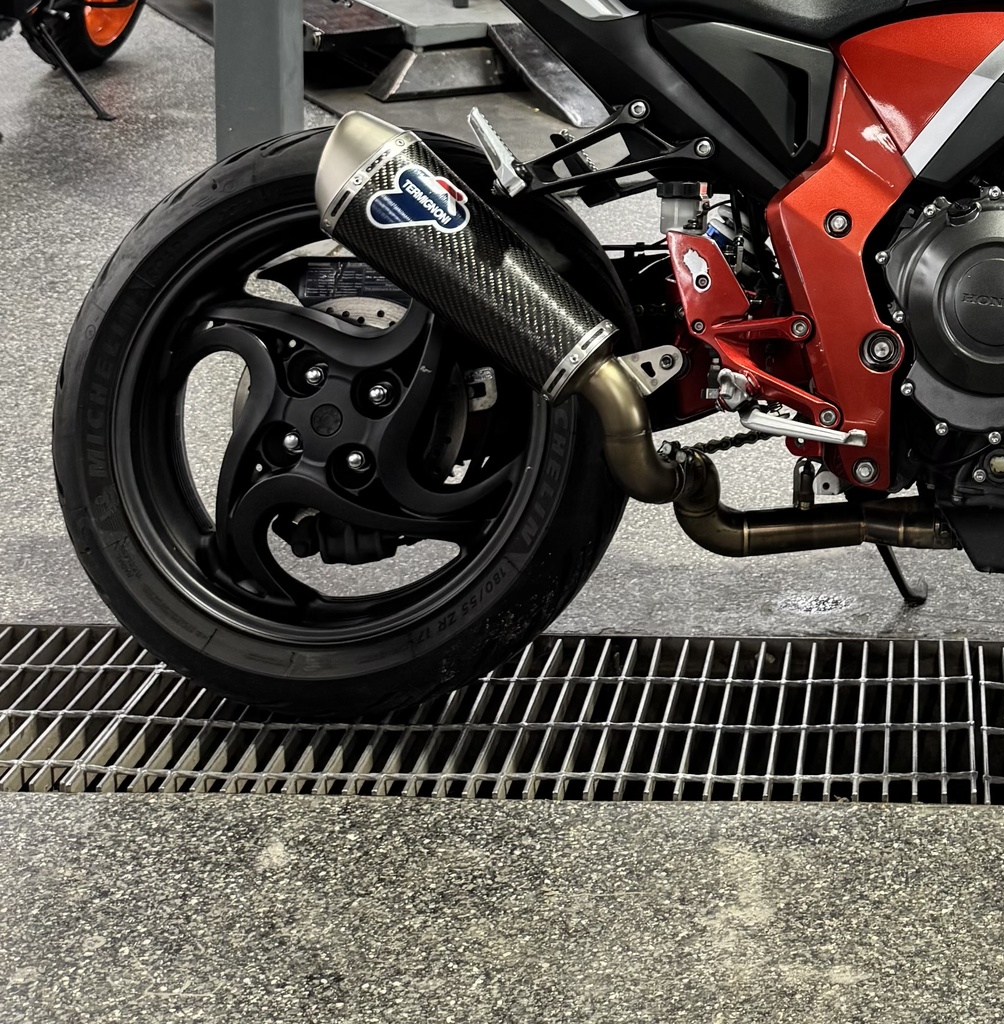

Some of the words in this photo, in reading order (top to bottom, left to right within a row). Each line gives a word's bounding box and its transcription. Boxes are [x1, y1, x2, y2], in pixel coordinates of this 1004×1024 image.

[401, 179, 452, 225] TERMIGNONI
[461, 567, 508, 616] 180/55
[438, 611, 457, 631] ZR
